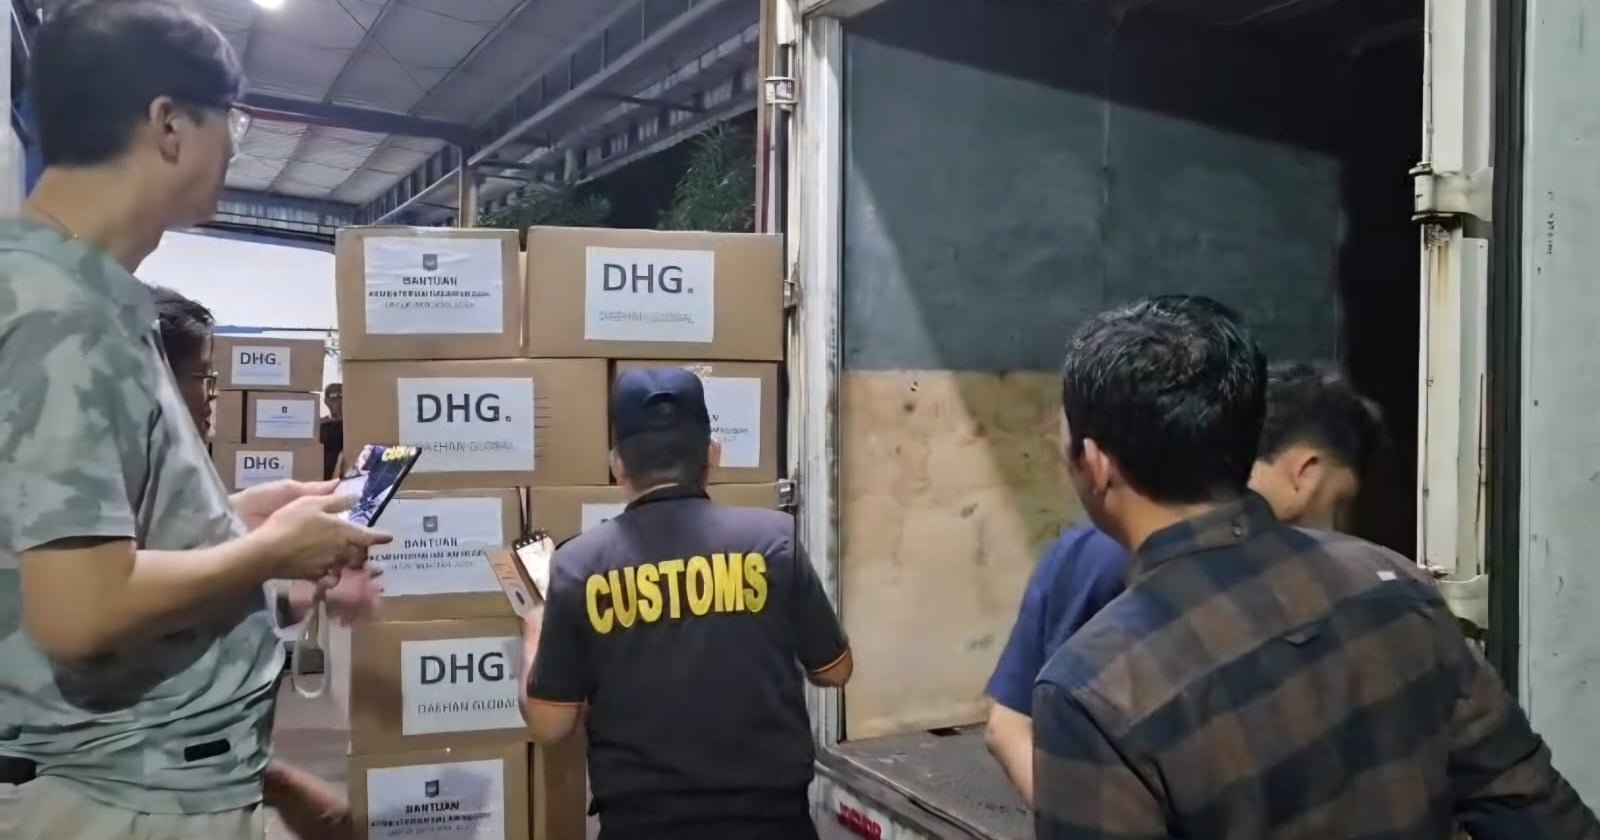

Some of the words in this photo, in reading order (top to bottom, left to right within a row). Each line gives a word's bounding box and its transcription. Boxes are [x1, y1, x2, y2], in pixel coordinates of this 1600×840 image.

[402, 276, 457, 286] BANTUAN
[603, 263, 694, 294] DHG.
[416, 393, 512, 423] DHG.
[404, 538, 457, 549] BANTUAN
[586, 552, 768, 634] CUSTOMS
[420, 652, 515, 685] DHG.
[406, 801, 460, 814] BANTUAN
